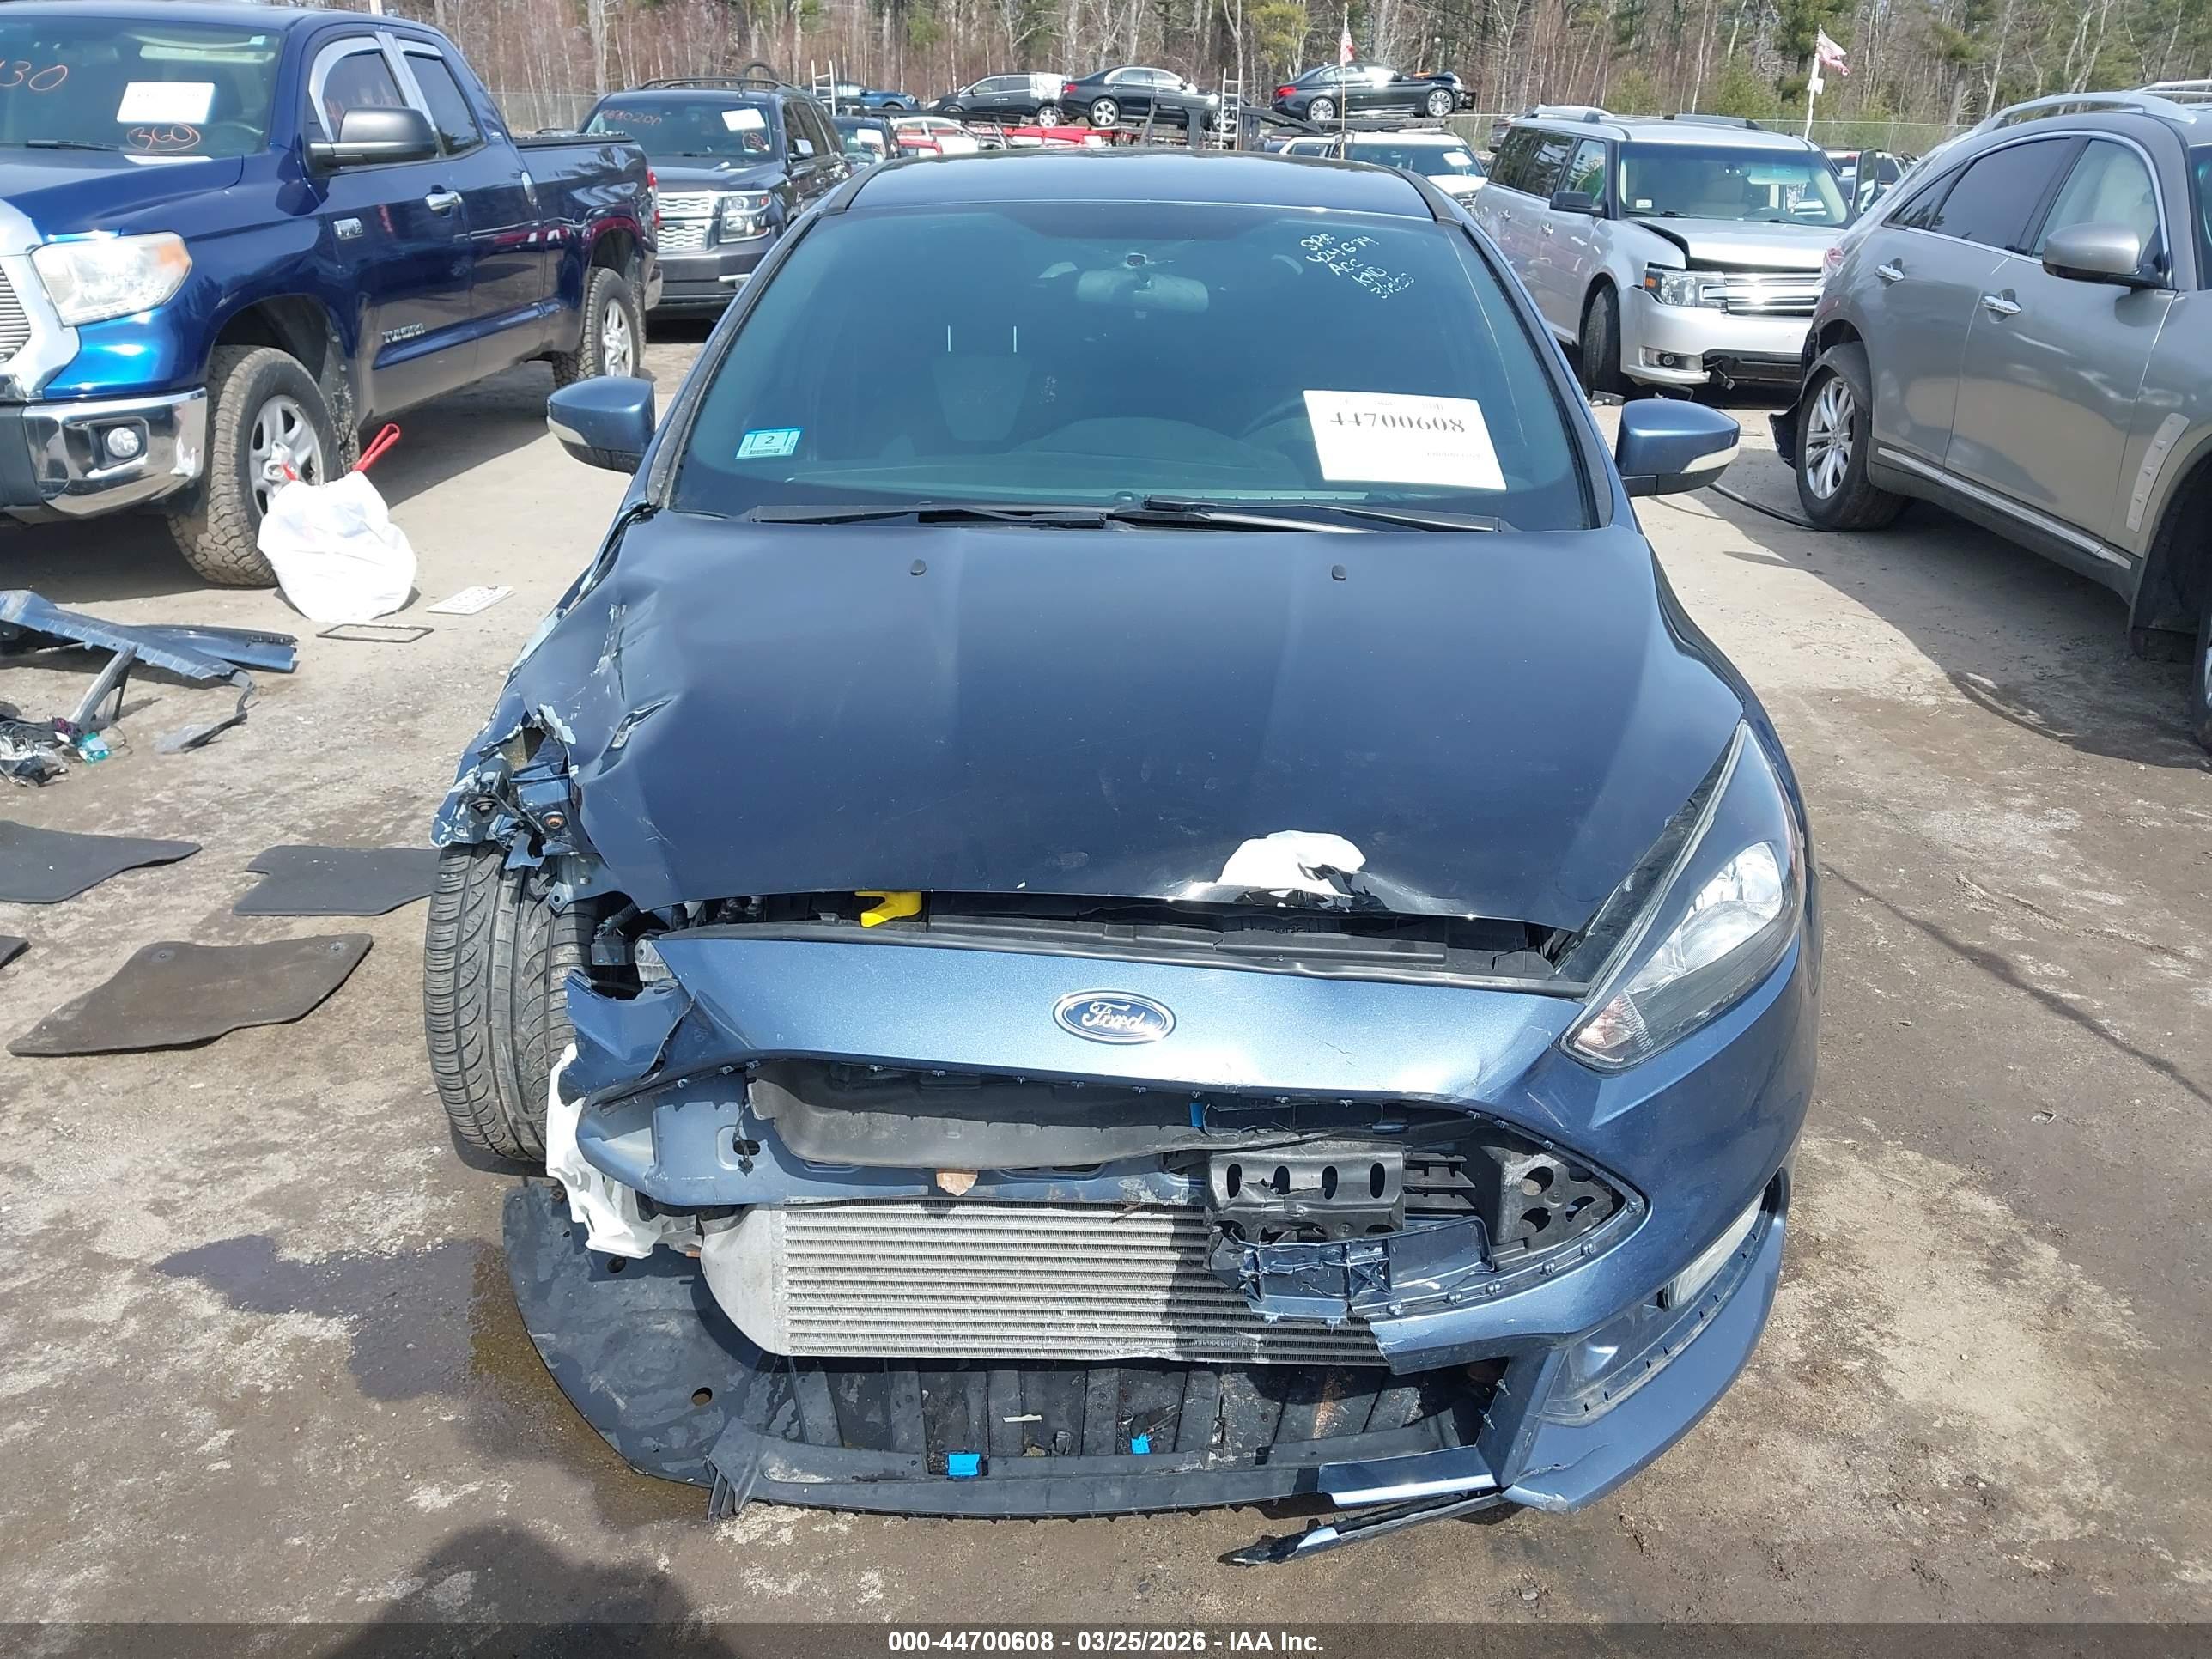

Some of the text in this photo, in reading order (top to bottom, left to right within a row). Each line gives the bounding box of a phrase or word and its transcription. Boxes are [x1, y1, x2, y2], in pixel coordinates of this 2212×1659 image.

[0, 59, 69, 91] 30
[130, 125, 193, 151] 360
[1328, 258, 1364, 276] ACC
[1330, 411, 1466, 434] 44700608
[763, 435, 775, 445] 2
[1081, 1001, 1149, 1031] Ford
